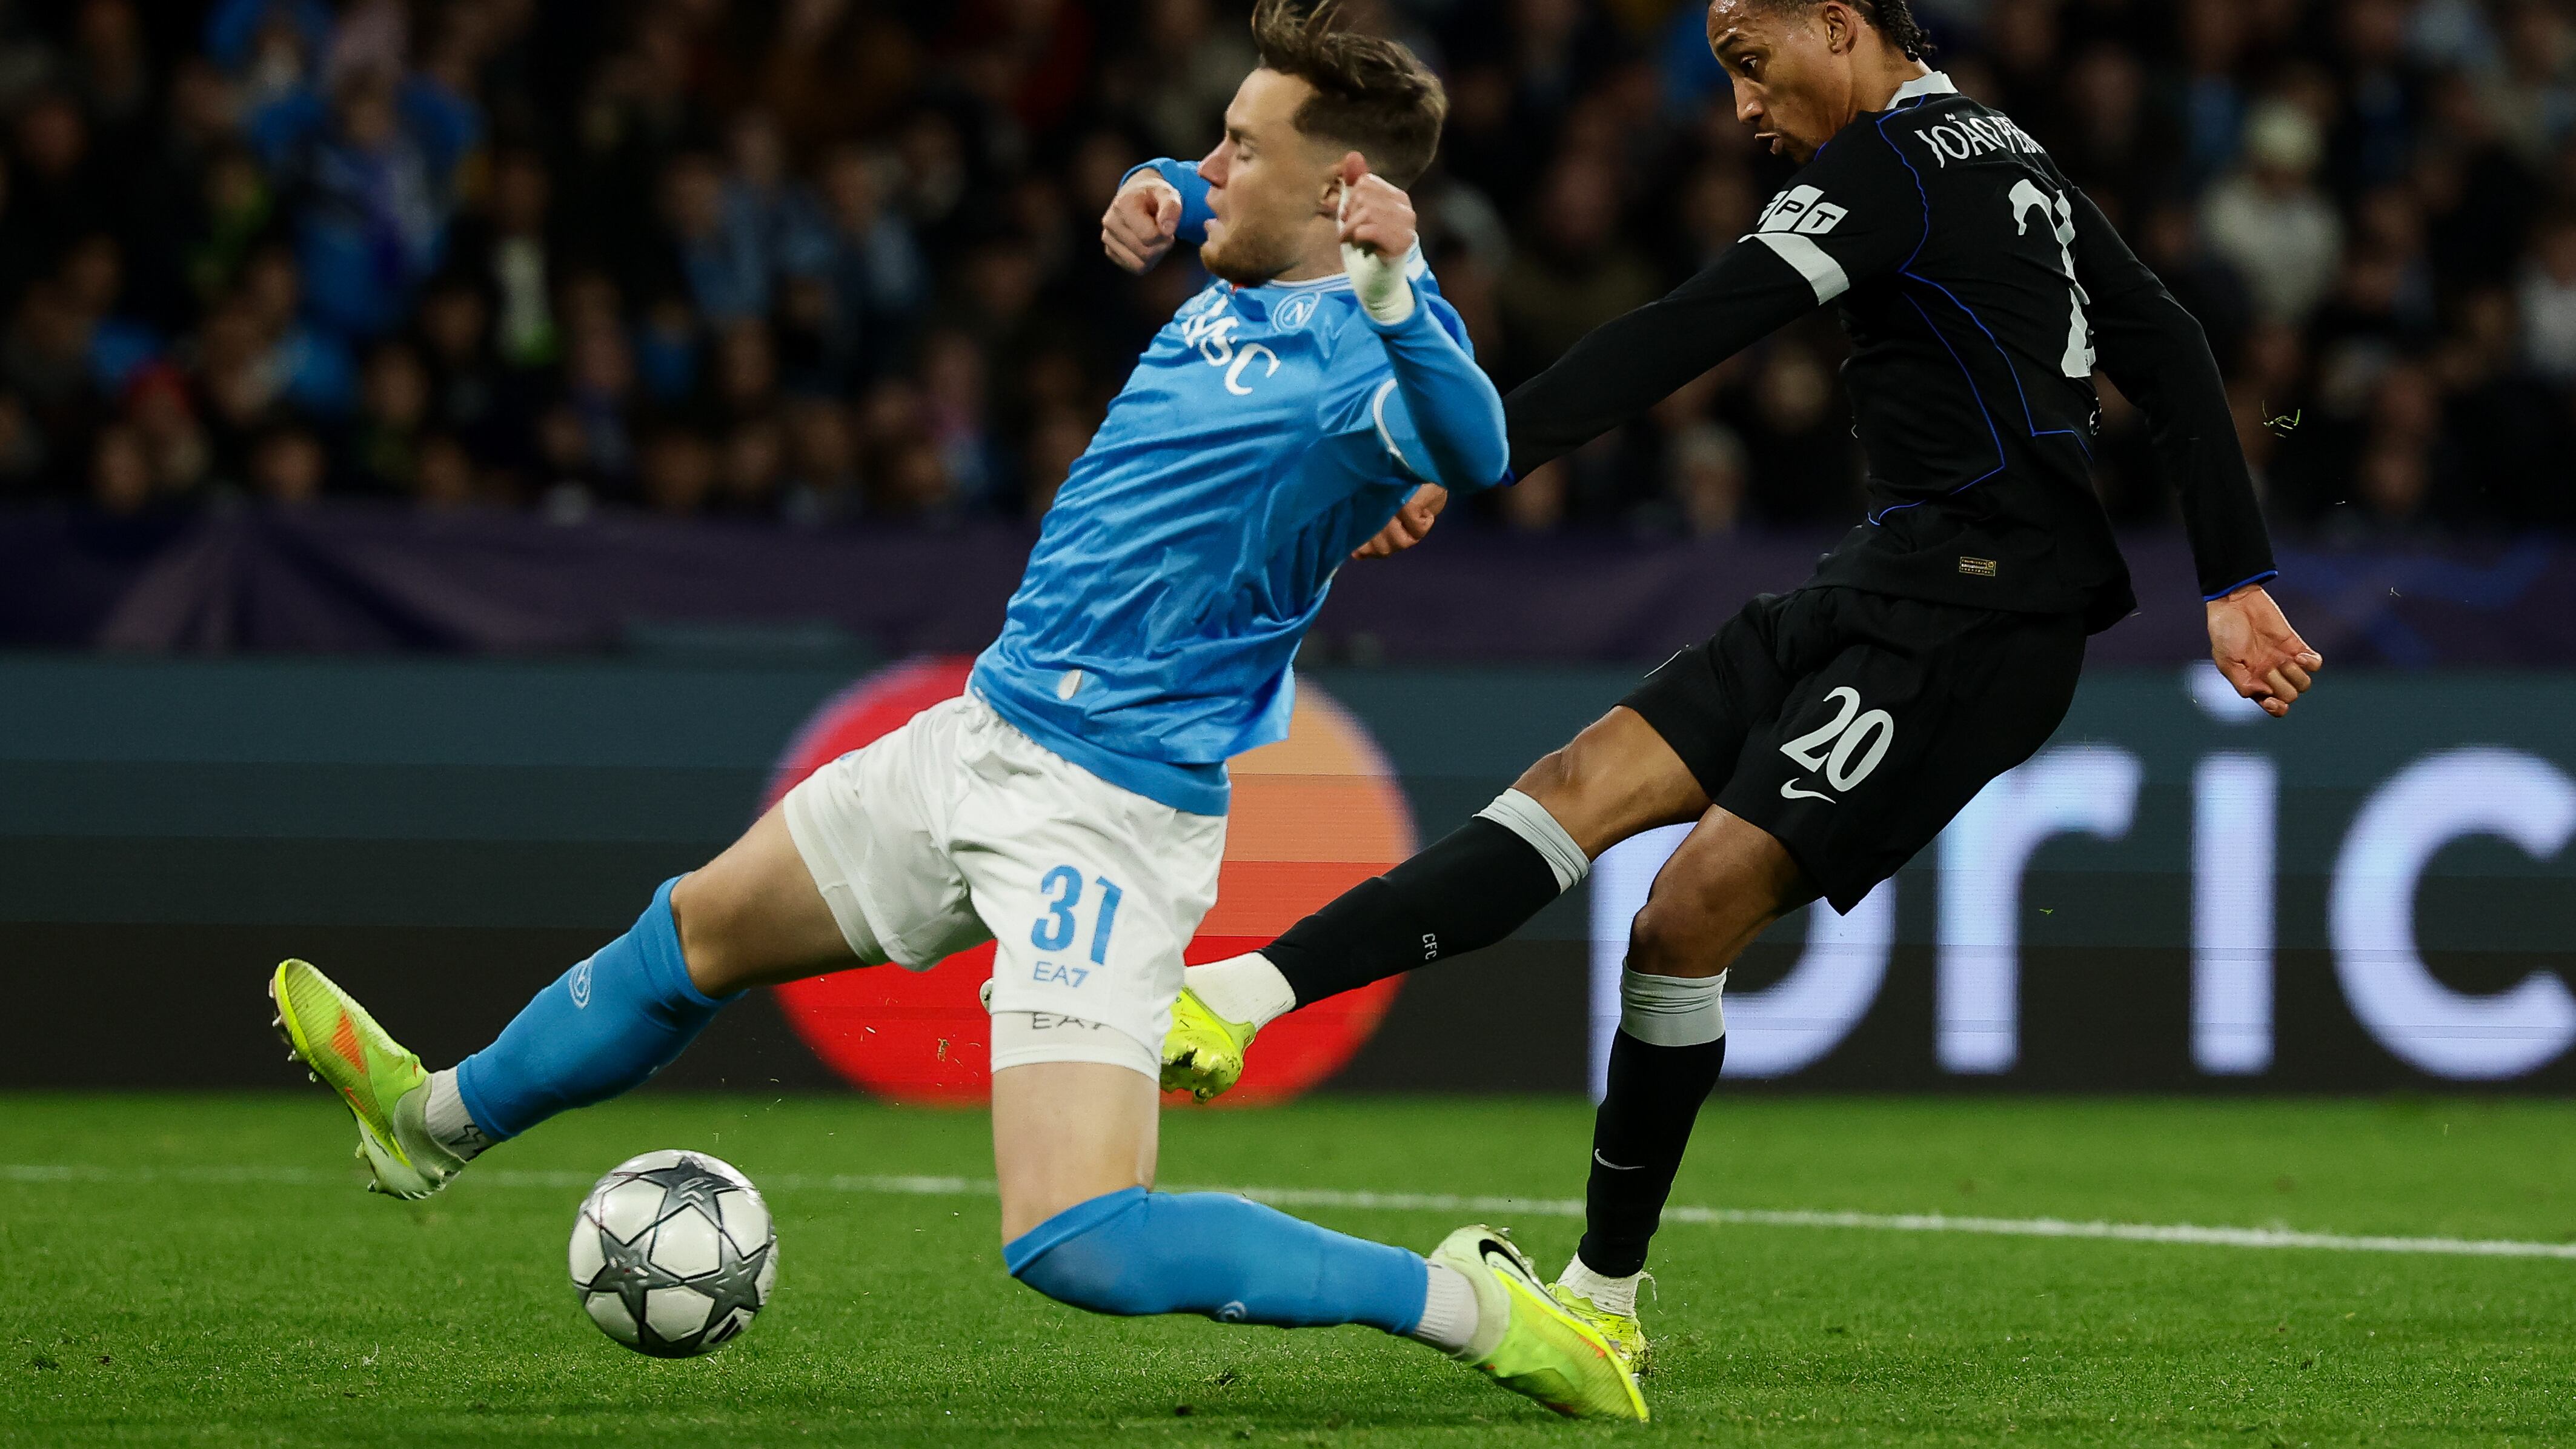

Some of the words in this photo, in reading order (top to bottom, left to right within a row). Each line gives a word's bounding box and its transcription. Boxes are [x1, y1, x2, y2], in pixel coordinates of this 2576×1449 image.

[1914, 112, 2007, 168] JOÃO
[2008, 178, 2096, 378] 2
[1779, 686, 1894, 792] 20
[1031, 864, 1123, 966] 31
[1422, 933, 1438, 960] CFC
[1033, 961, 1089, 988] EA7
